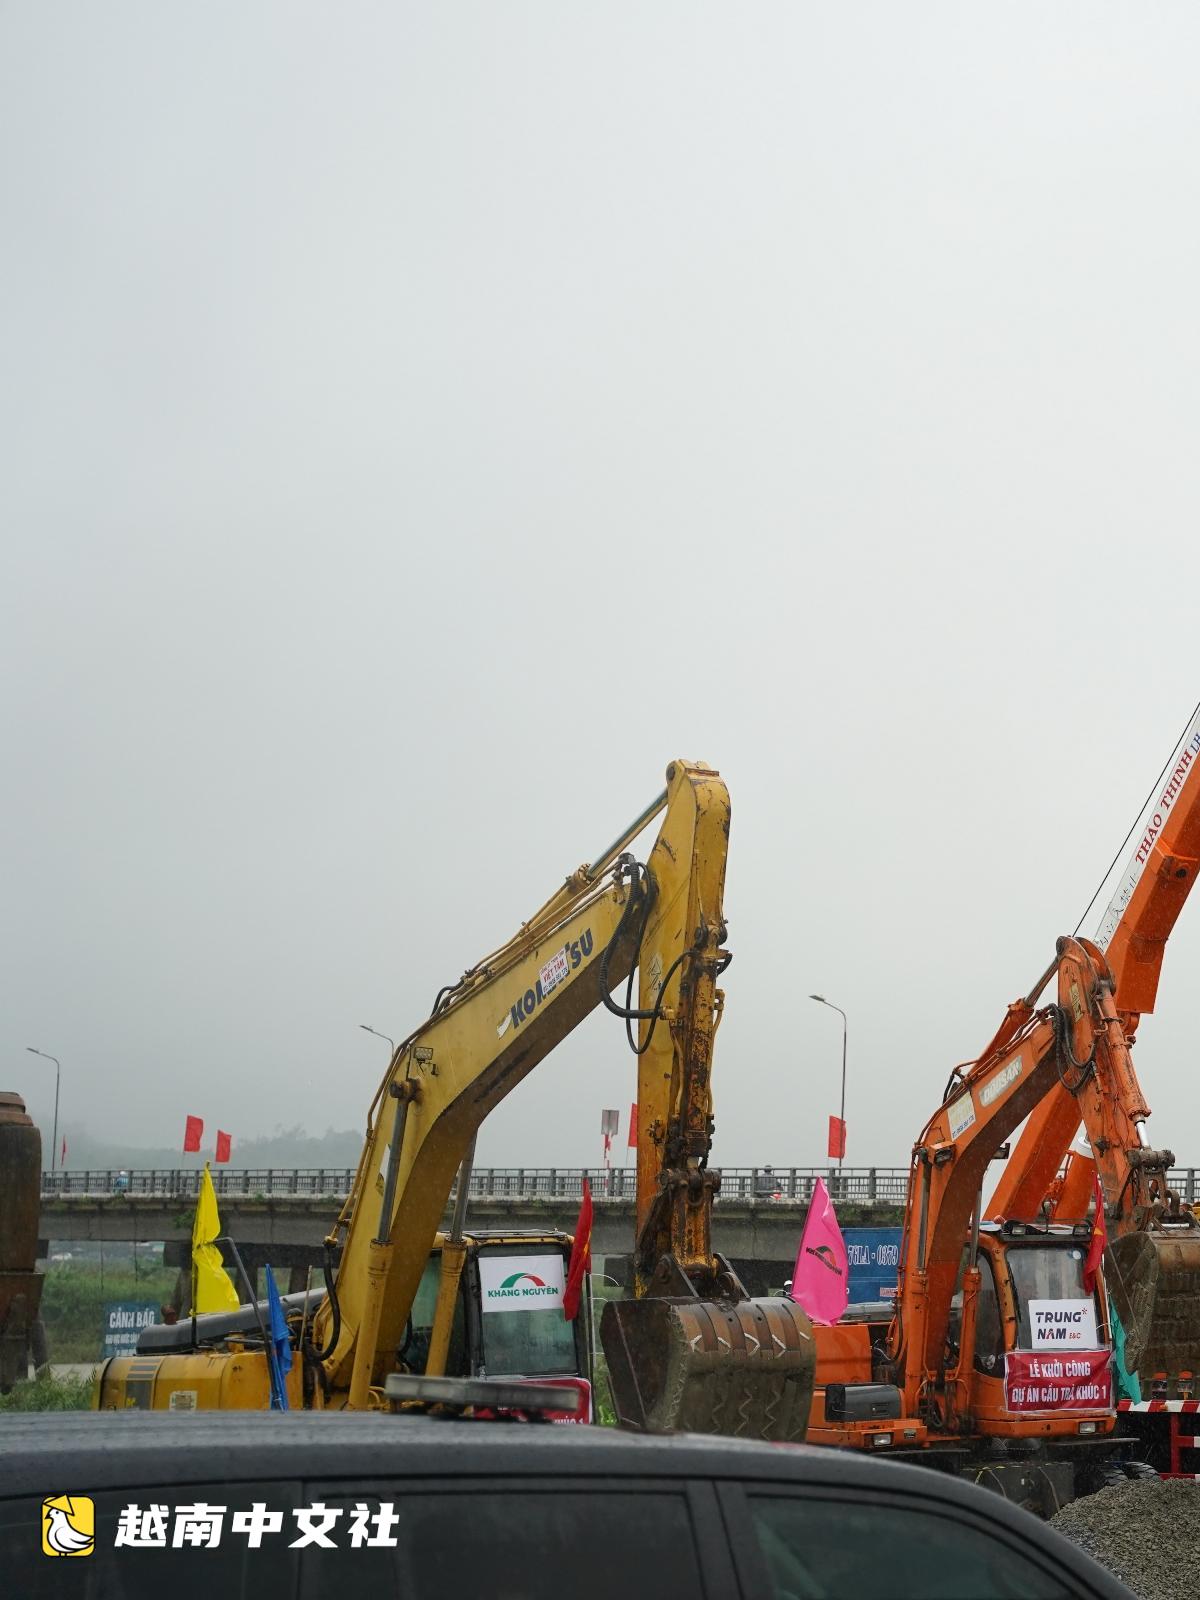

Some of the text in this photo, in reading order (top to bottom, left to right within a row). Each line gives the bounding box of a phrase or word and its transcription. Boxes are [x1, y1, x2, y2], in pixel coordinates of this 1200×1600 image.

[1160, 748, 1194, 811] THỊNH
[487, 1285, 559, 1298] KHANG NGUYÊN
[109, 1306, 135, 1329] CẢNH
[1035, 1311, 1082, 1323] TRUNG
[1037, 1328, 1081, 1340] NAM E&C
[1029, 1358, 1091, 1378] LỄ KHỞI CÔNG
[1011, 1386, 1026, 1406] DỰ
[1026, 1384, 1040, 1403] ÁN
[1041, 1382, 1059, 1403] CẦU
[1075, 1382, 1100, 1401] KHÚC
[1101, 1385, 1107, 1400] 1
